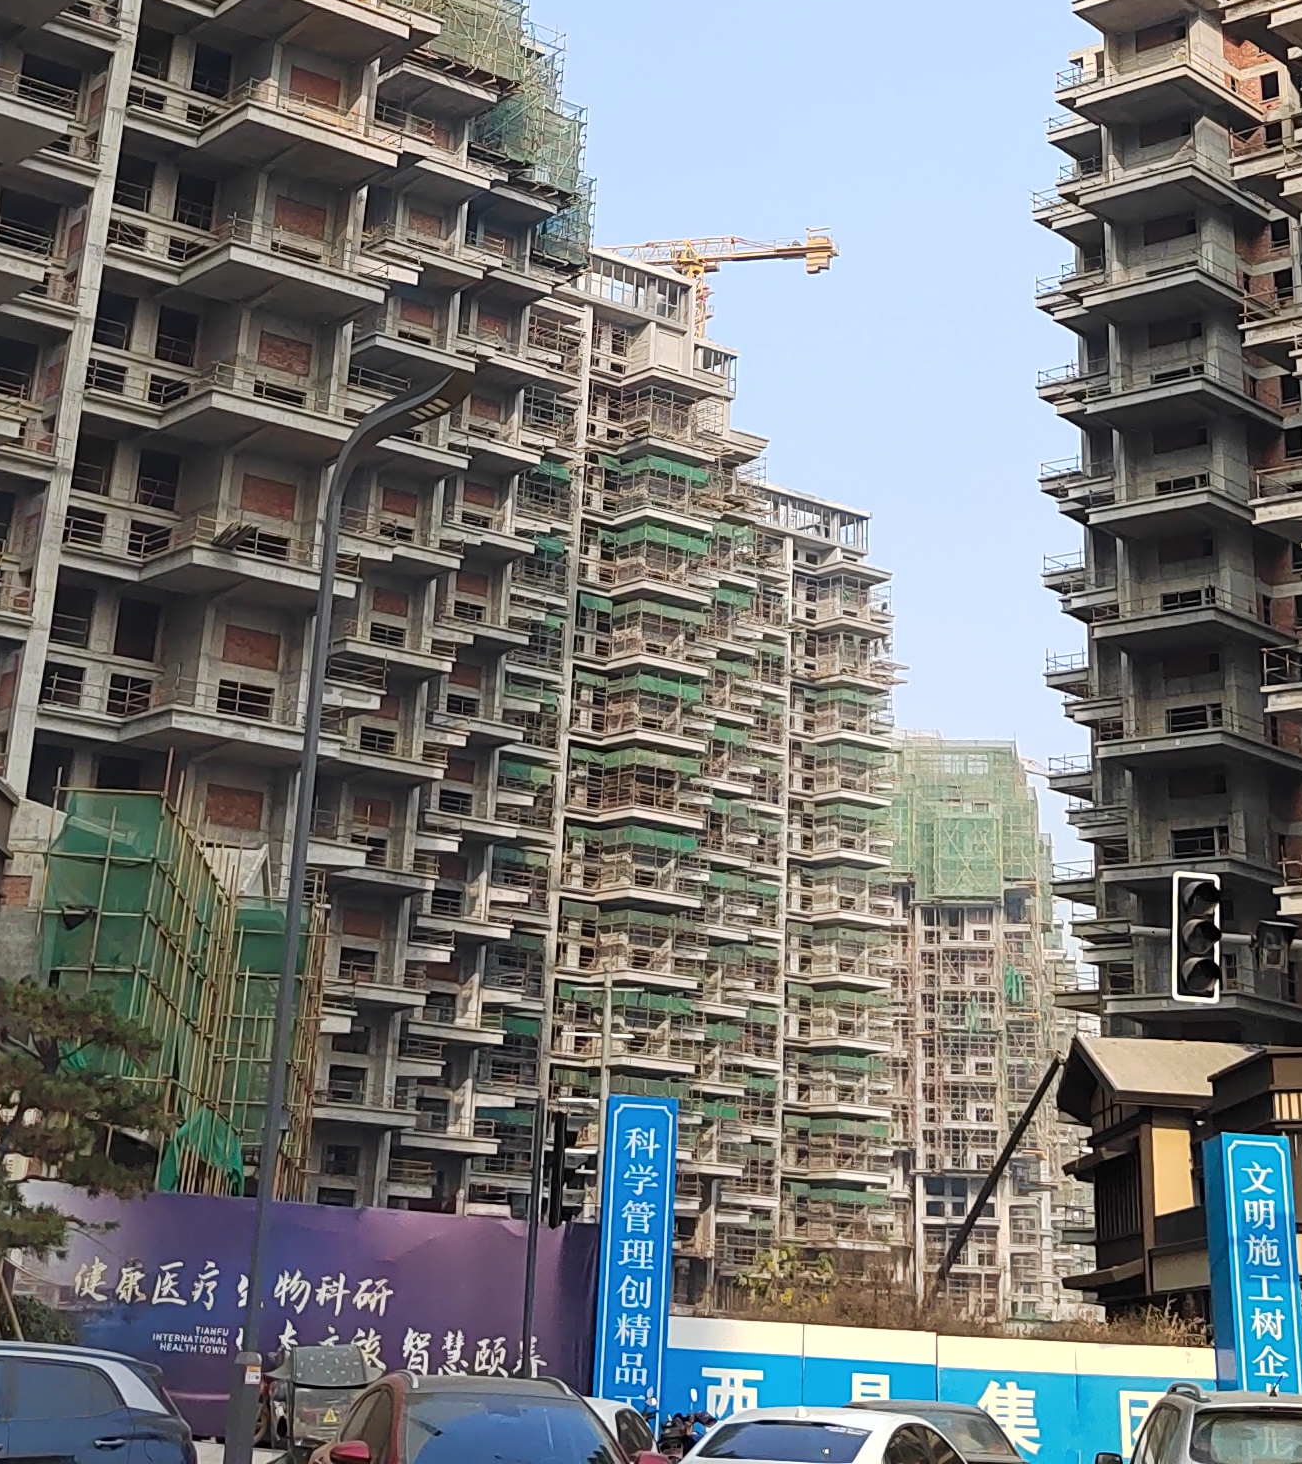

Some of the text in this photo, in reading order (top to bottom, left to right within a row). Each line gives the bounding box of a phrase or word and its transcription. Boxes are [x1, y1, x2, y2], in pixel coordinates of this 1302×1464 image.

[75, 1256, 220, 1311] 健康医疗
[195, 1325, 229, 1336] TIANFU
[152, 1332, 228, 1346] INTERNATIONAL
[159, 1342, 227, 1355] HEALTH TOWN
